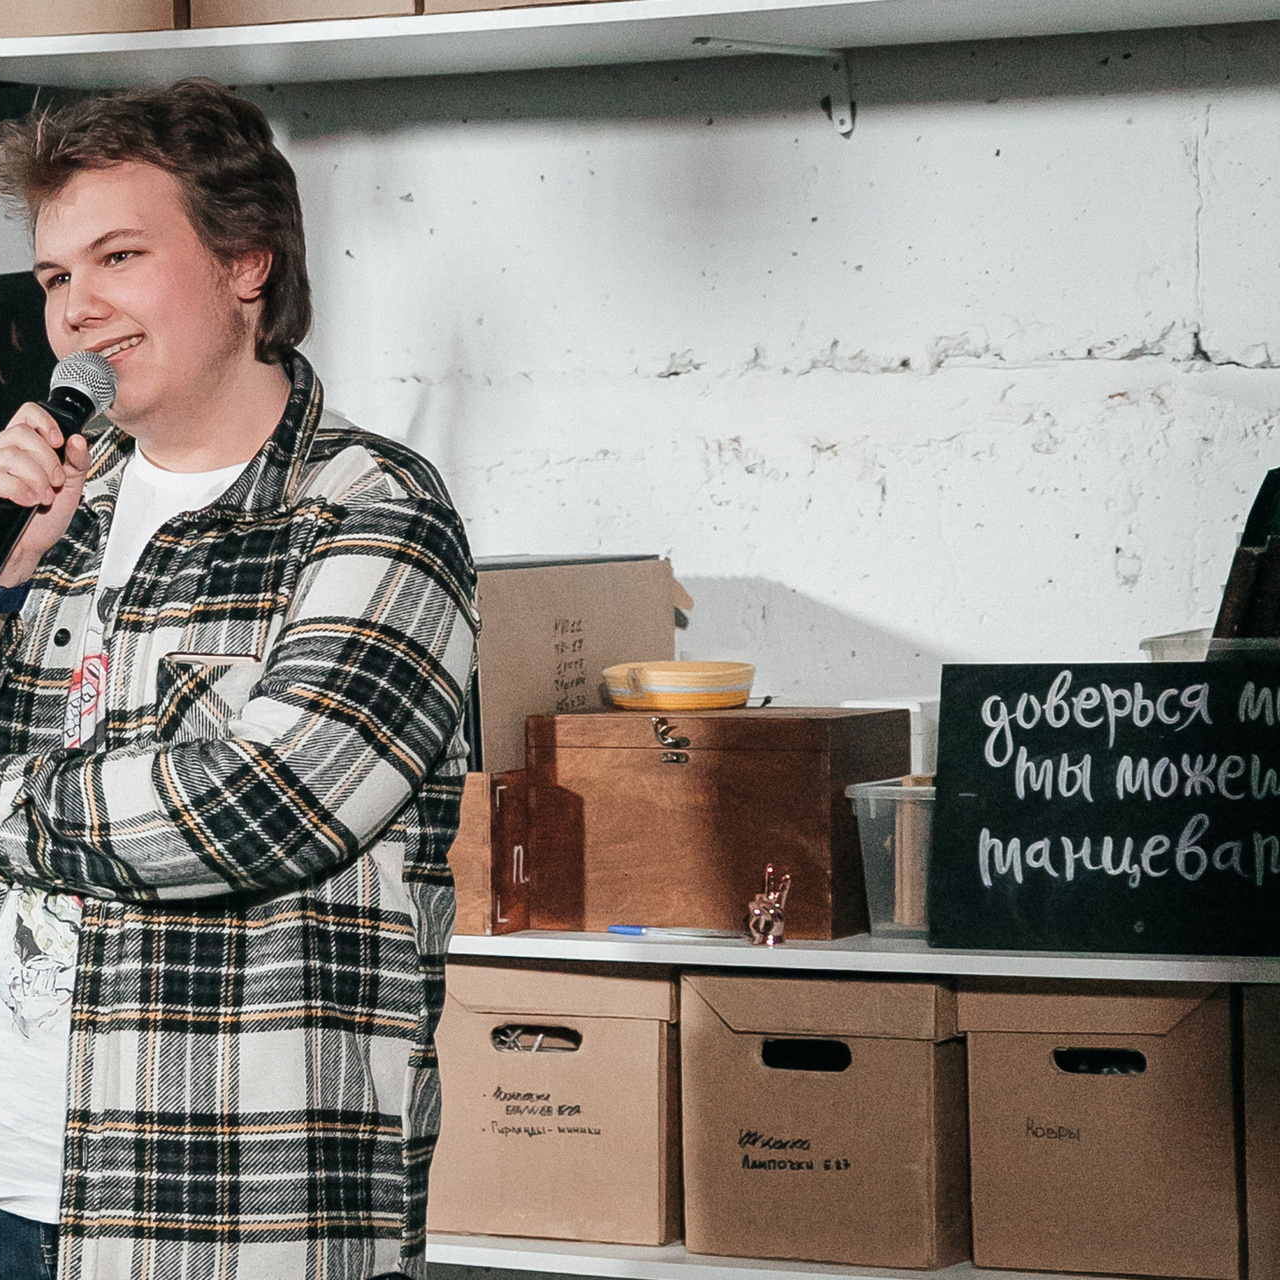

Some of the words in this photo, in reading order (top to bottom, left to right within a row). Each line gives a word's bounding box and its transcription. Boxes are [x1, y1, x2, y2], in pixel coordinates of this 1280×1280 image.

[981, 670, 1214, 768] доверься
[1238, 681, 1280, 726] м
[1015, 746, 1094, 803] ты
[1025, 1116, 1081, 1142] Ковры
[741, 1153, 814, 1172] Лампочки
